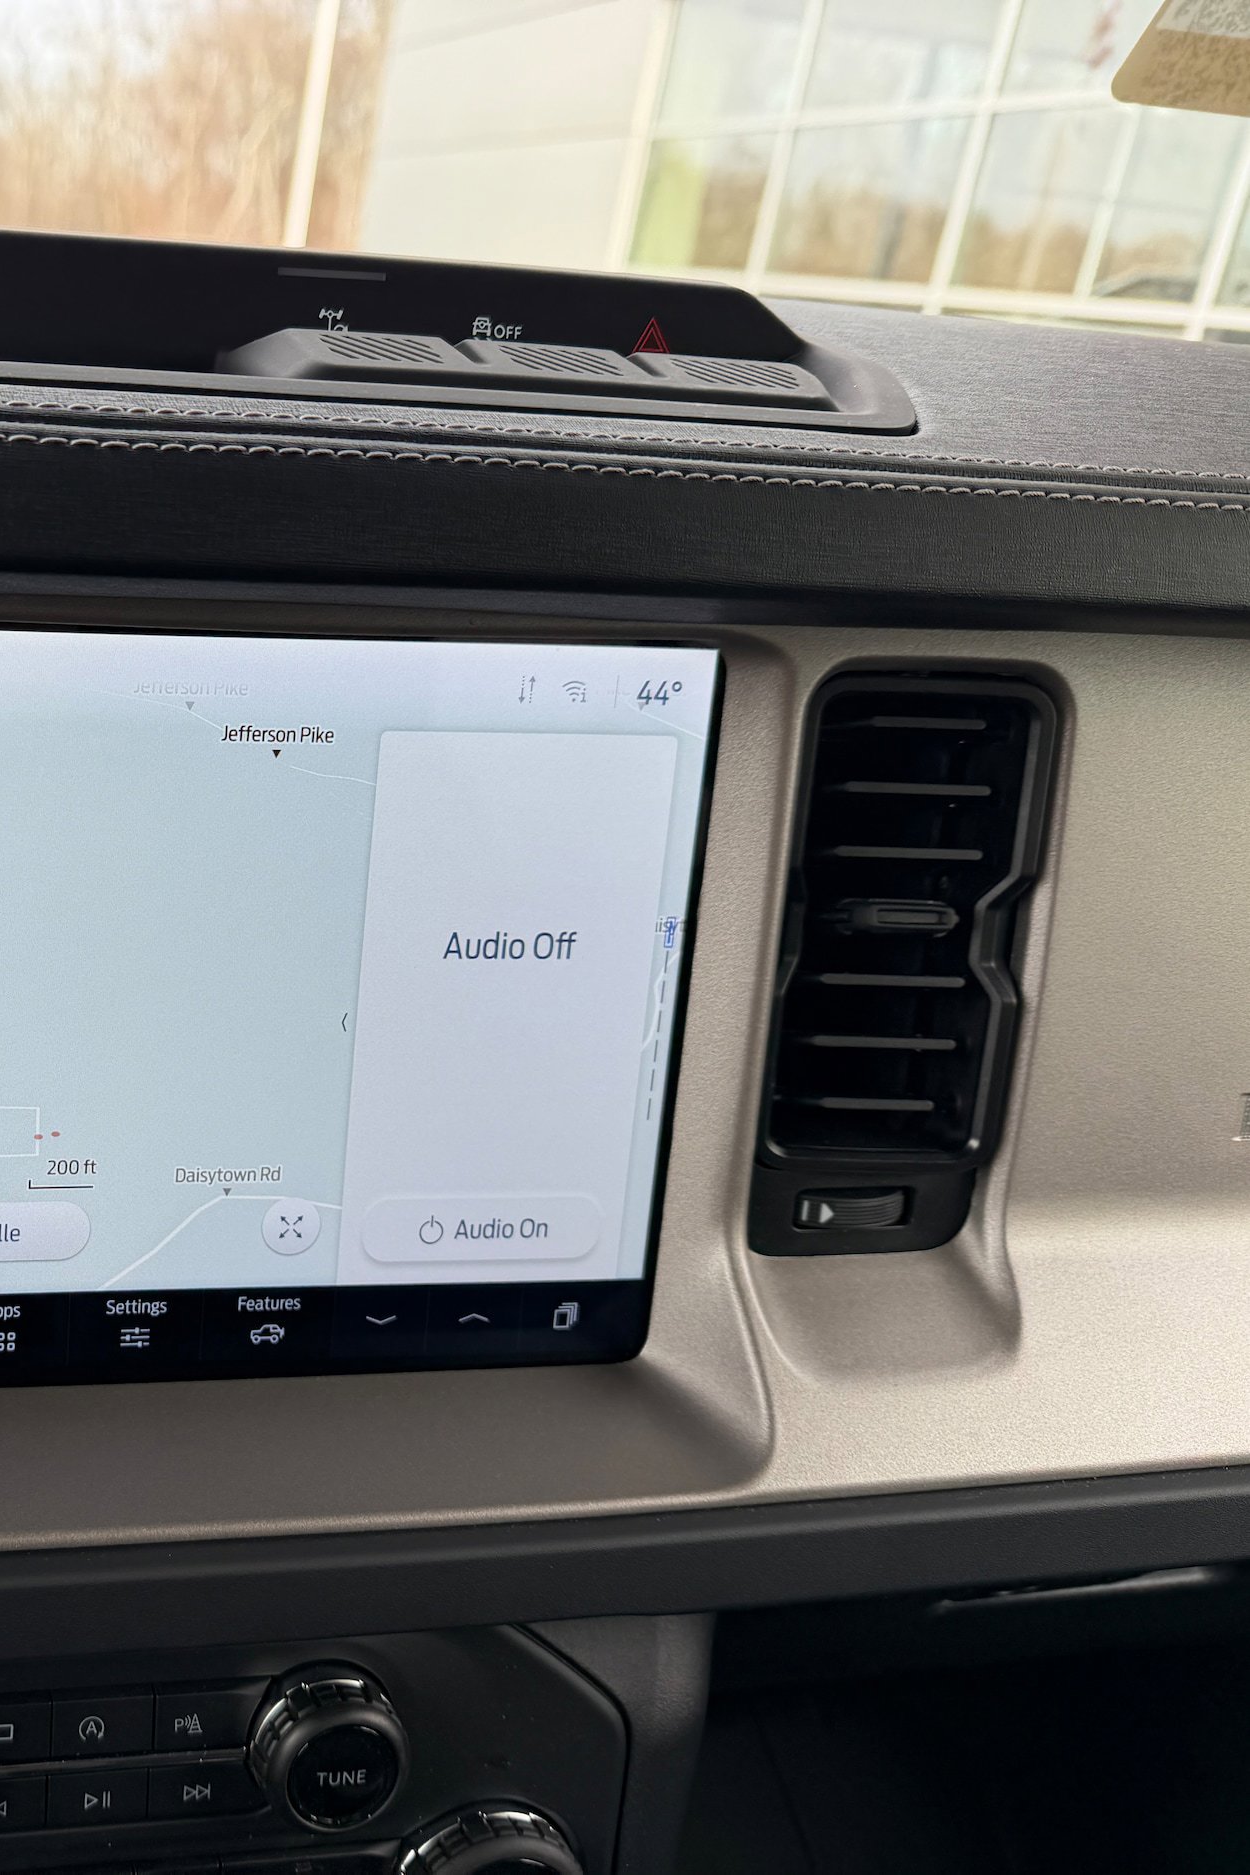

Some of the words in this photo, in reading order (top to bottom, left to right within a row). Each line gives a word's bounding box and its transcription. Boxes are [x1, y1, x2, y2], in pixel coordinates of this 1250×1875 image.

[493, 324, 523, 340] OFF
[221, 725, 296, 743] Jefferson
[299, 726, 335, 744] Pike
[444, 932, 525, 960] Audio
[533, 930, 577, 960] Off
[47, 1160, 80, 1176] 200
[84, 1159, 97, 1175] ft
[175, 1167, 256, 1187] Daisytown
[259, 1166, 281, 1182] Rd
[454, 1218, 515, 1239] Audio
[520, 1218, 549, 1238] On
[106, 1299, 168, 1317] Settings
[237, 1296, 301, 1313] Features
[316, 1768, 368, 1788] TUNE
